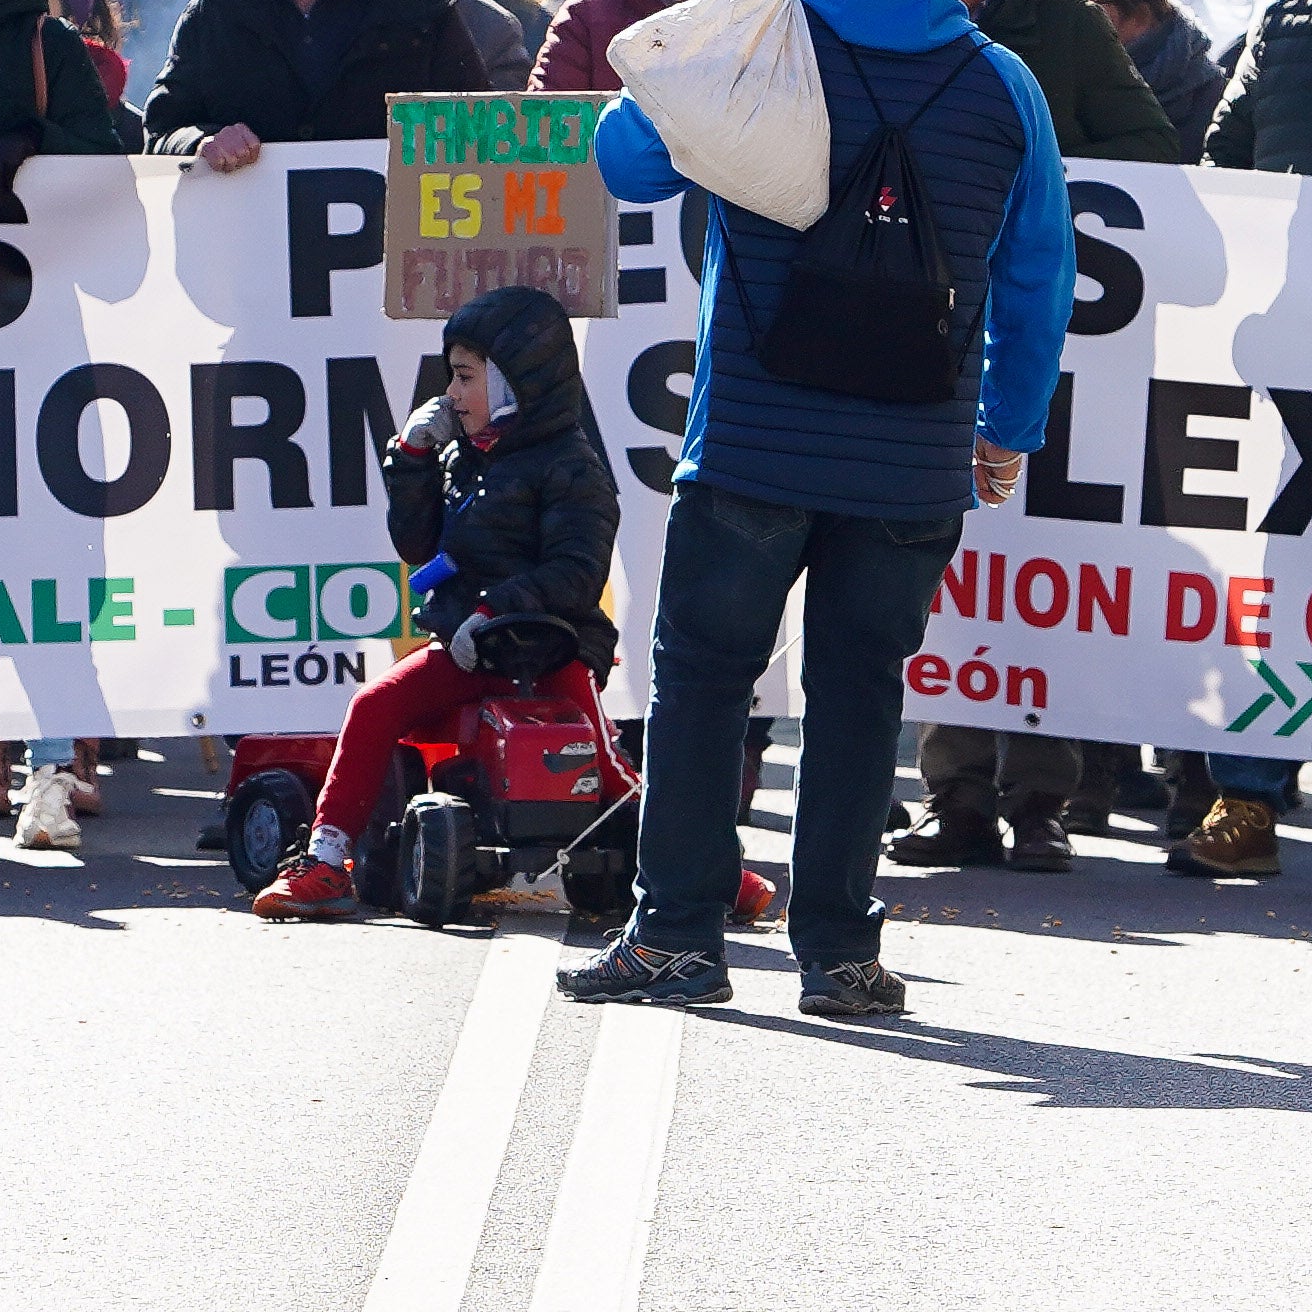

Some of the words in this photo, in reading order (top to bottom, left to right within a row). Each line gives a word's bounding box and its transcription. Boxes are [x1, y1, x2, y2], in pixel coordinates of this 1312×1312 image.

[419, 172, 482, 239] ES
[503, 170, 567, 235] MI
[930, 549, 1133, 637] NION
[1164, 570, 1275, 647] DE
[229, 644, 366, 688] LEÓN
[906, 645, 1048, 709] eón
